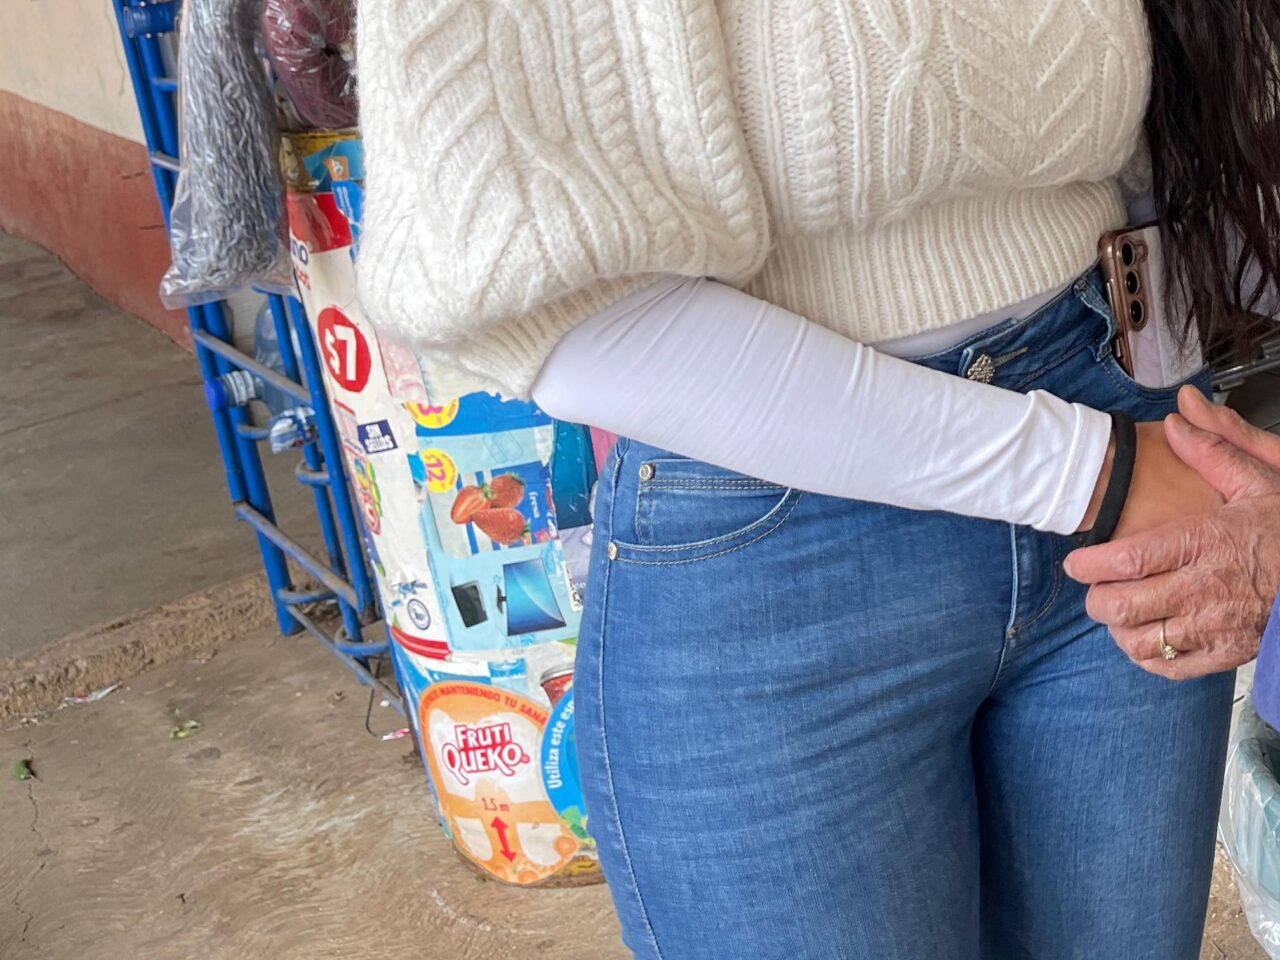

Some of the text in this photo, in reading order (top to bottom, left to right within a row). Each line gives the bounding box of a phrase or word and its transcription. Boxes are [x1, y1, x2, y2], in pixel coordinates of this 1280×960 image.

[324, 324, 357, 381] $7
[454, 722, 512, 750] FRUTI
[551, 720, 566, 746] este
[441, 742, 524, 786] QUEKO
[544, 748, 563, 790] Utiliza
